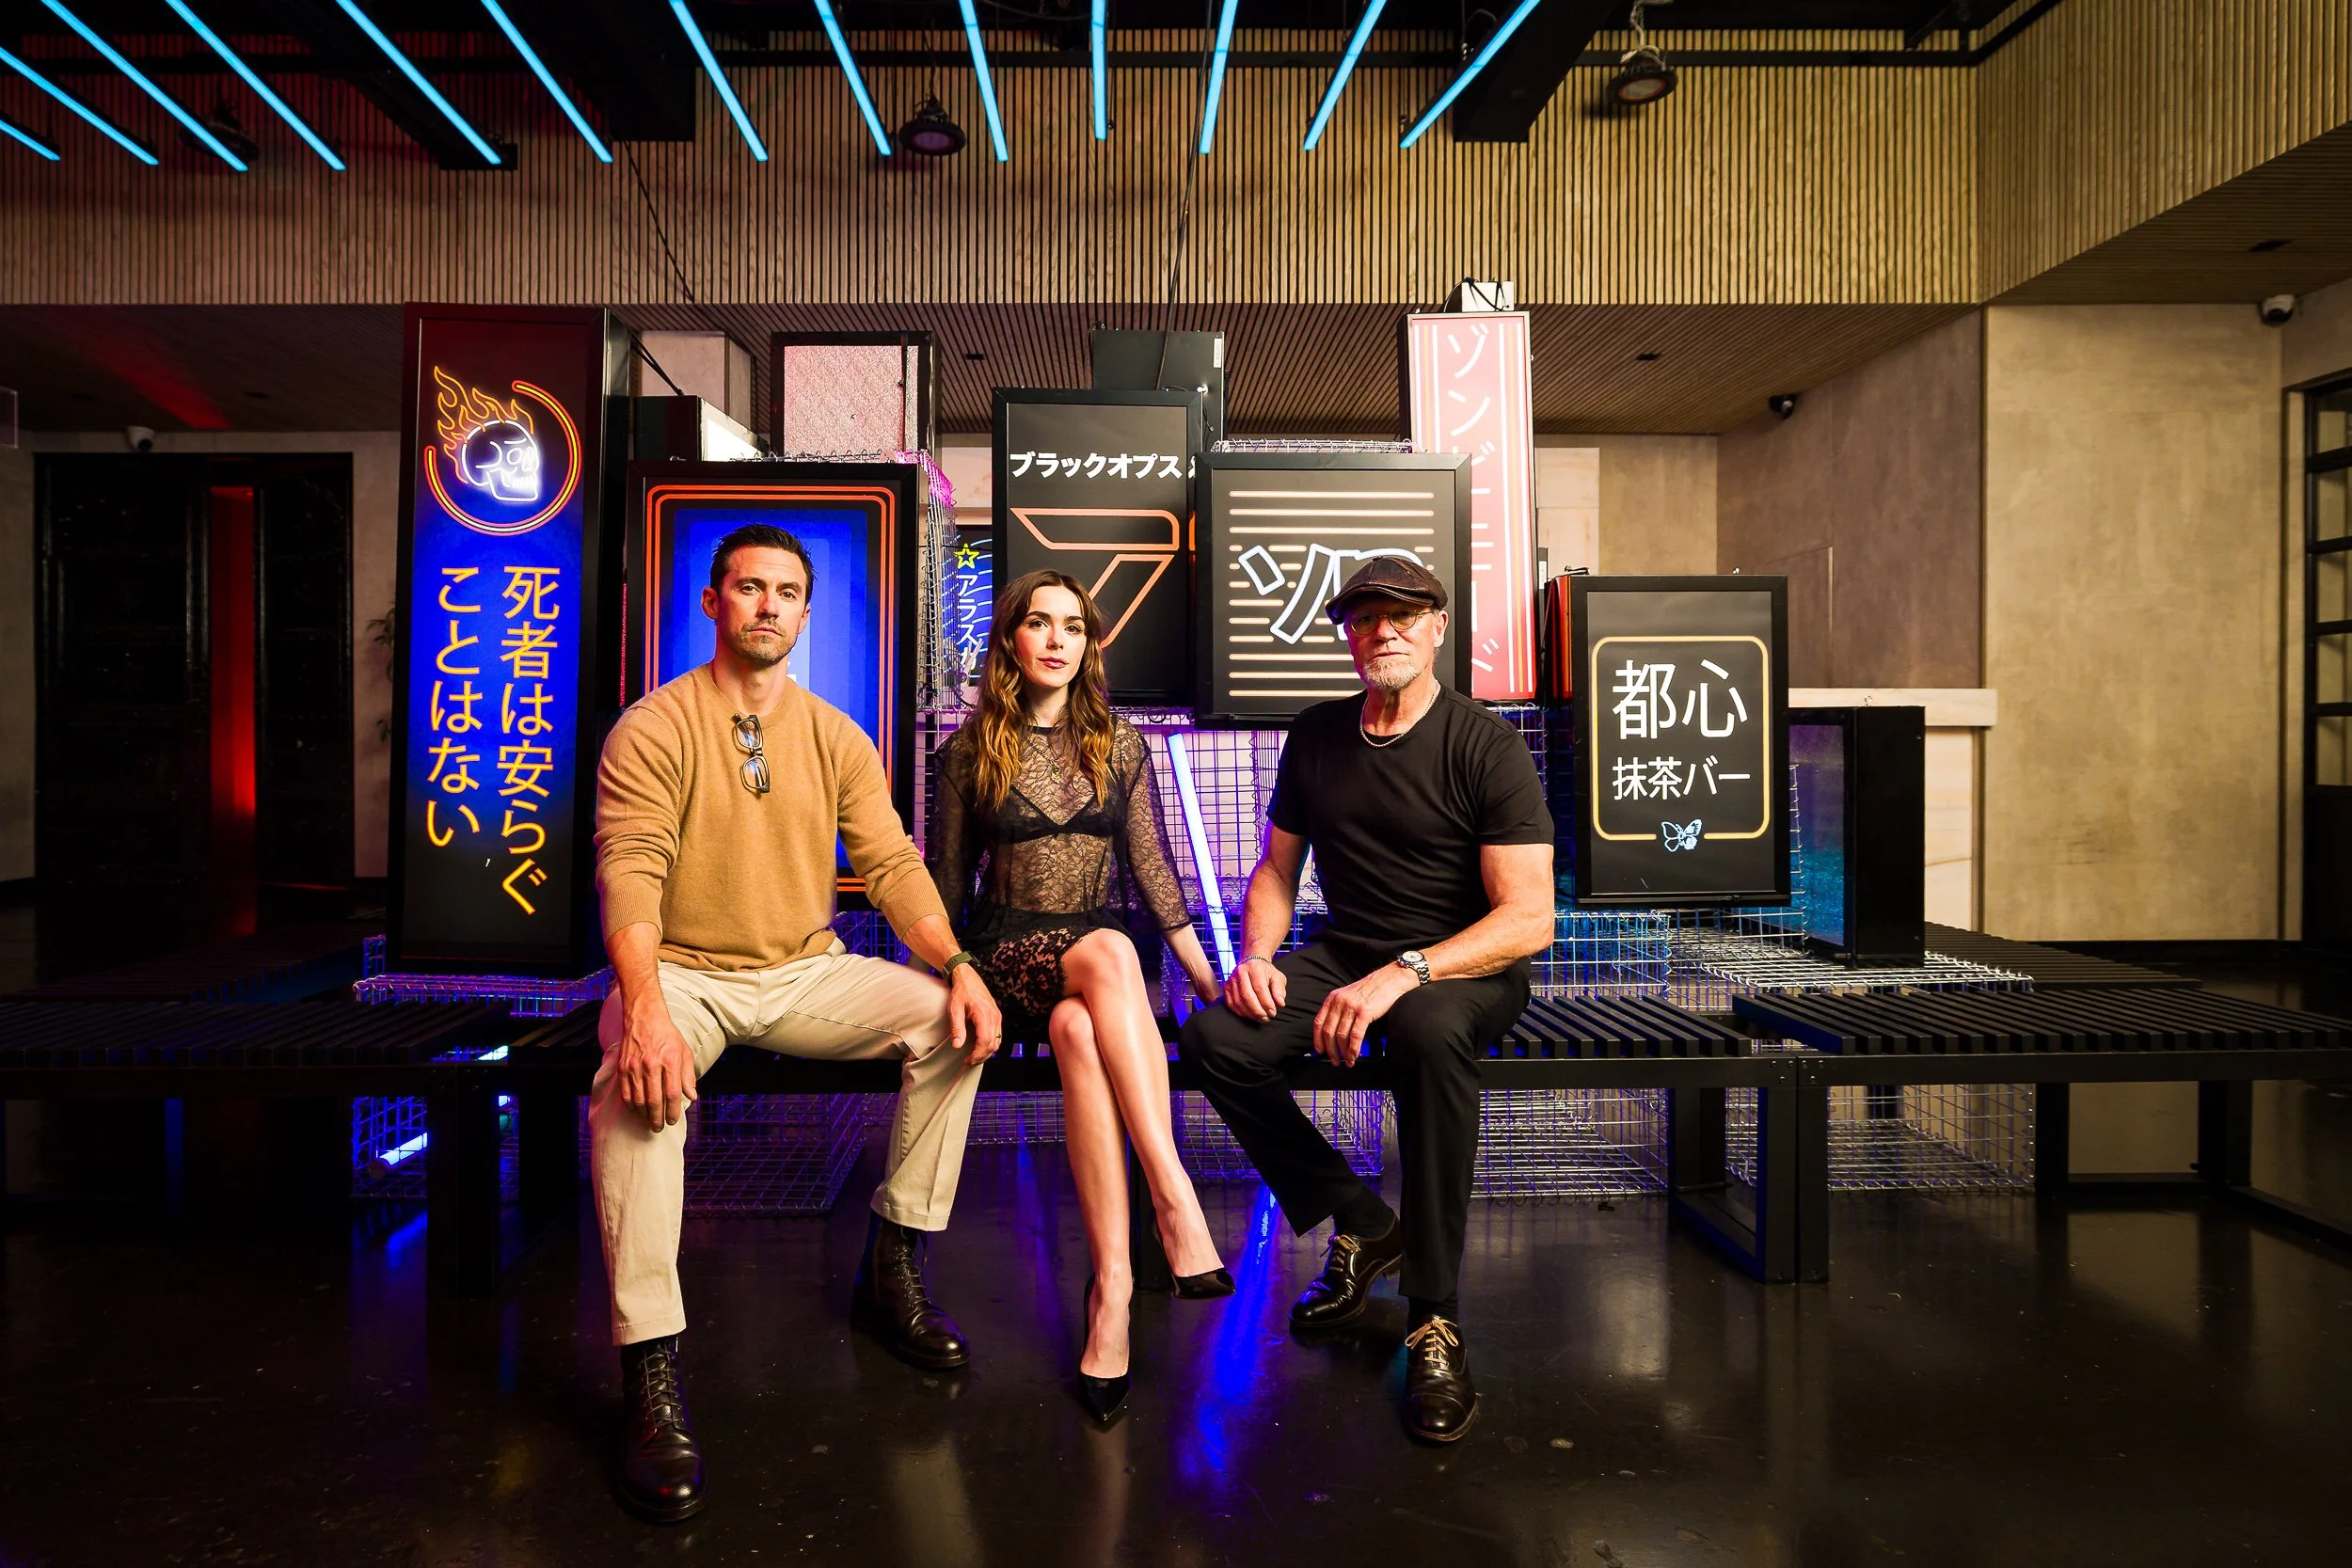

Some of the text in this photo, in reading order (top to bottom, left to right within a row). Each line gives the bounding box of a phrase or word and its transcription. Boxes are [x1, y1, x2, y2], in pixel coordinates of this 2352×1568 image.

[1009, 451, 1184, 479] ブラックオプス
[427, 566, 483, 847] ことはない
[497, 566, 561, 914] 死者は安らぐ
[1612, 658, 1748, 741] 都心
[1612, 754, 1751, 800] 抹茶バー
